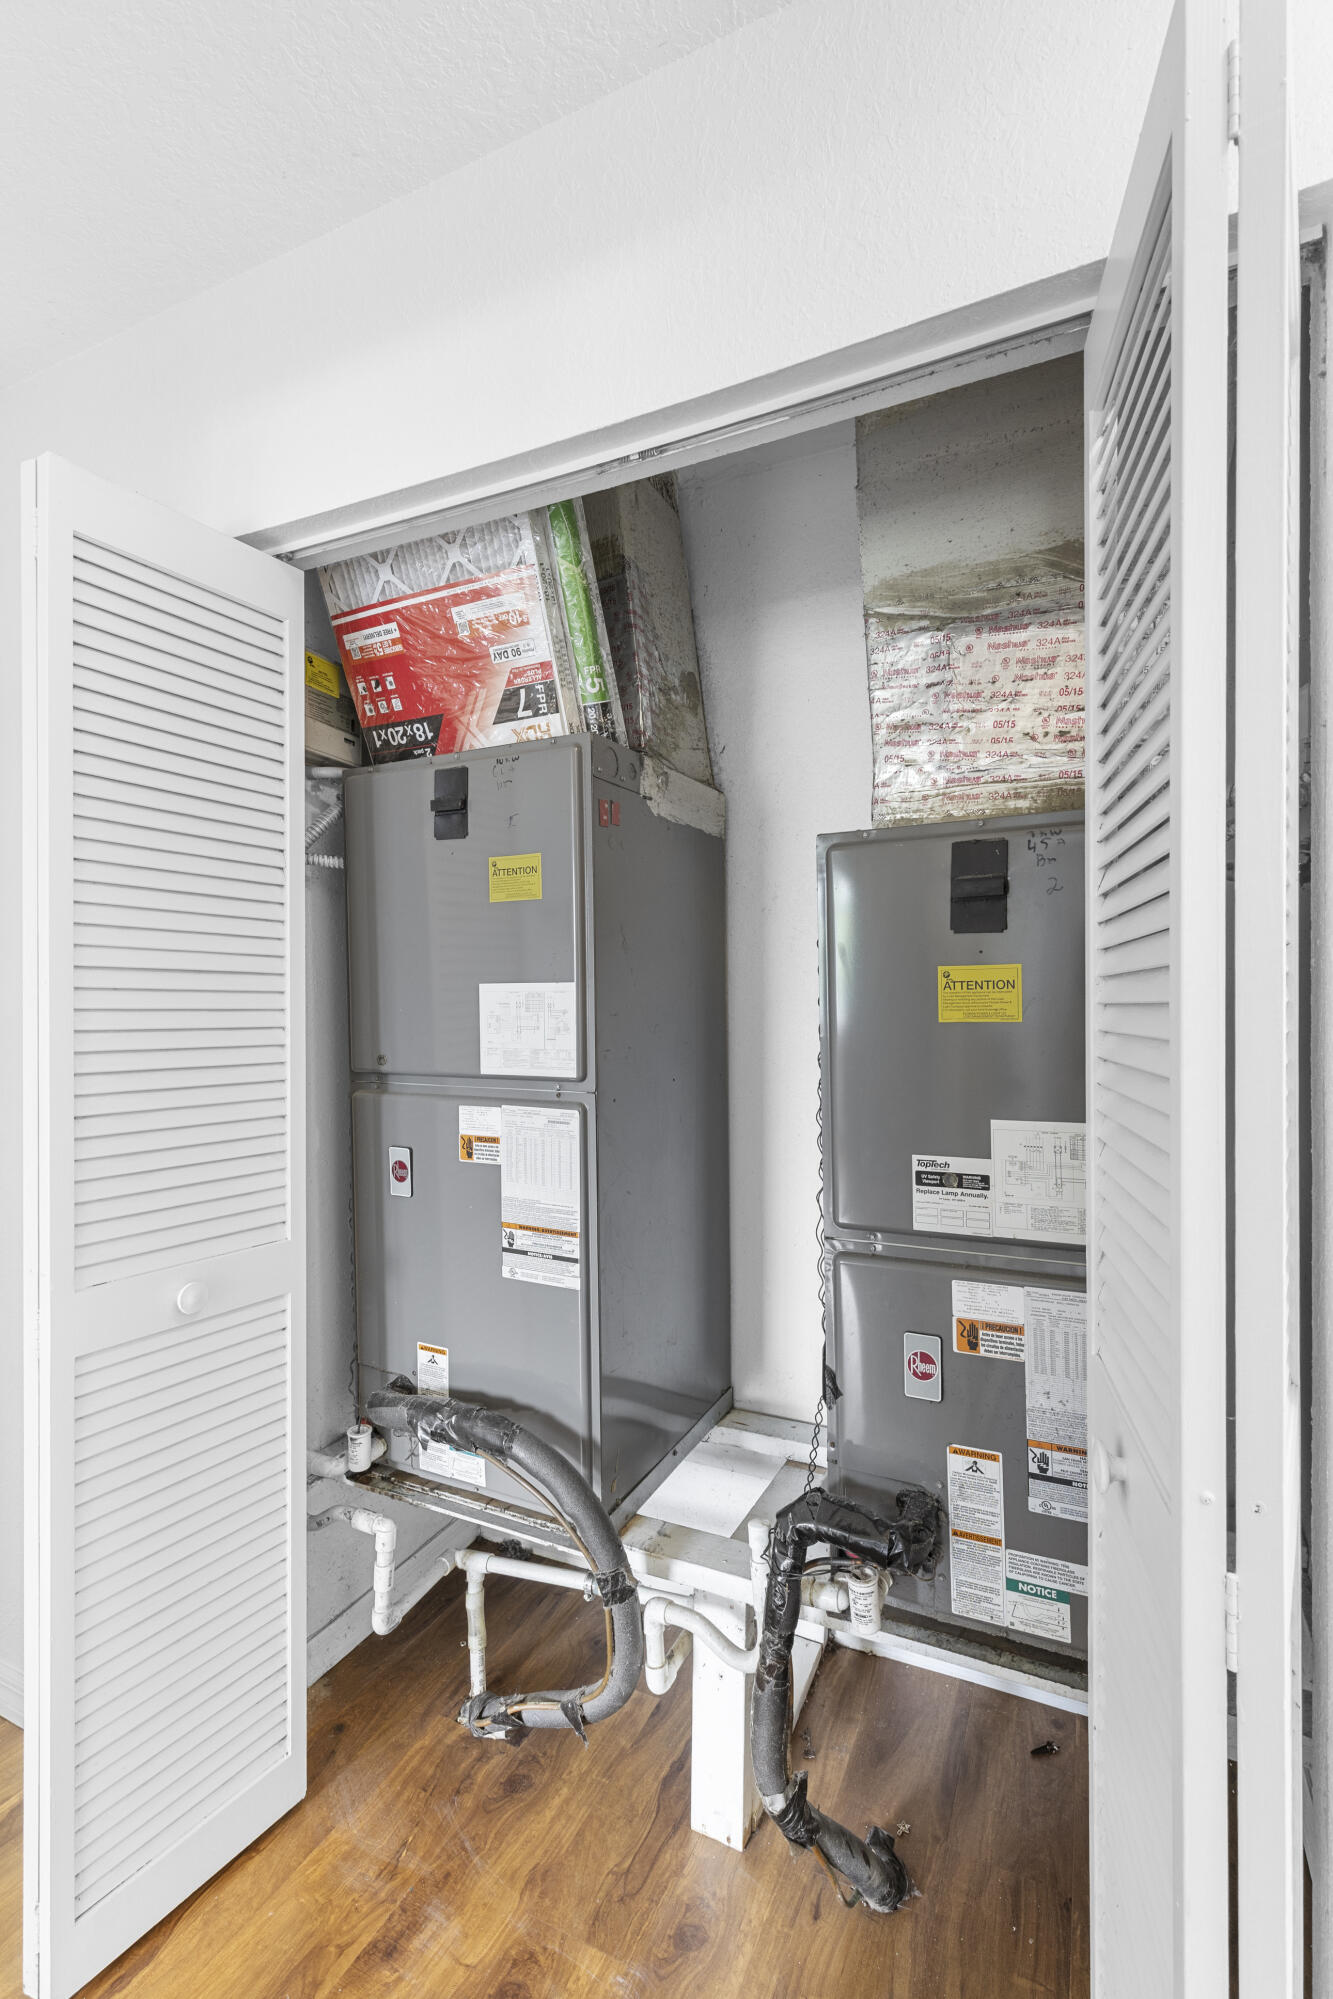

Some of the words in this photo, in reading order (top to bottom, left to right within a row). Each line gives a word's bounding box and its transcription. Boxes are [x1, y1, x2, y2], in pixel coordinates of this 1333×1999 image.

[1008, 608, 1032, 618] 324A
[1037, 619, 1062, 629] 324A
[930, 633, 951, 644] 05/15
[987, 640, 1030, 651] Nashua
[1036, 636, 1061, 647] 324A
[493, 650, 509, 661] DAY
[511, 647, 522, 657] 90
[1016, 655, 1060, 665] Nashua
[1065, 653, 1085, 662] 324
[584, 664, 601, 675] FPR
[926, 664, 947, 673] 324A
[586, 677, 605, 693] 5
[535, 684, 548, 714] FPR
[991, 690, 1013, 699] 324A
[1059, 688, 1084, 697] 05/15
[518, 688, 533, 718] 7
[928, 722, 950, 731] 324A
[993, 720, 1016, 729] 05/15
[1055, 716, 1085, 726] Nash
[373, 722, 434, 748] 18x20x1
[425, 748, 433, 757] 2
[985, 750, 1010, 758] 324A
[1058, 769, 1083, 779] 05/15
[988, 791, 1013, 801] 324A
[492, 865, 538, 877] ATTENTION
[943, 979, 1016, 991] ATTENTION
[916, 1159, 950, 1169] TopTech
[916, 1188, 940, 1196] Replace
[960, 1191, 989, 1200] Annually.
[910, 1352, 936, 1377] Rheem
[958, 1448, 997, 1462] WARNING
[1056, 1446, 1087, 1456] WARNIN
[959, 1531, 1002, 1546] AVERTISSEMENT
[1018, 1582, 1057, 1599] NOTICE
